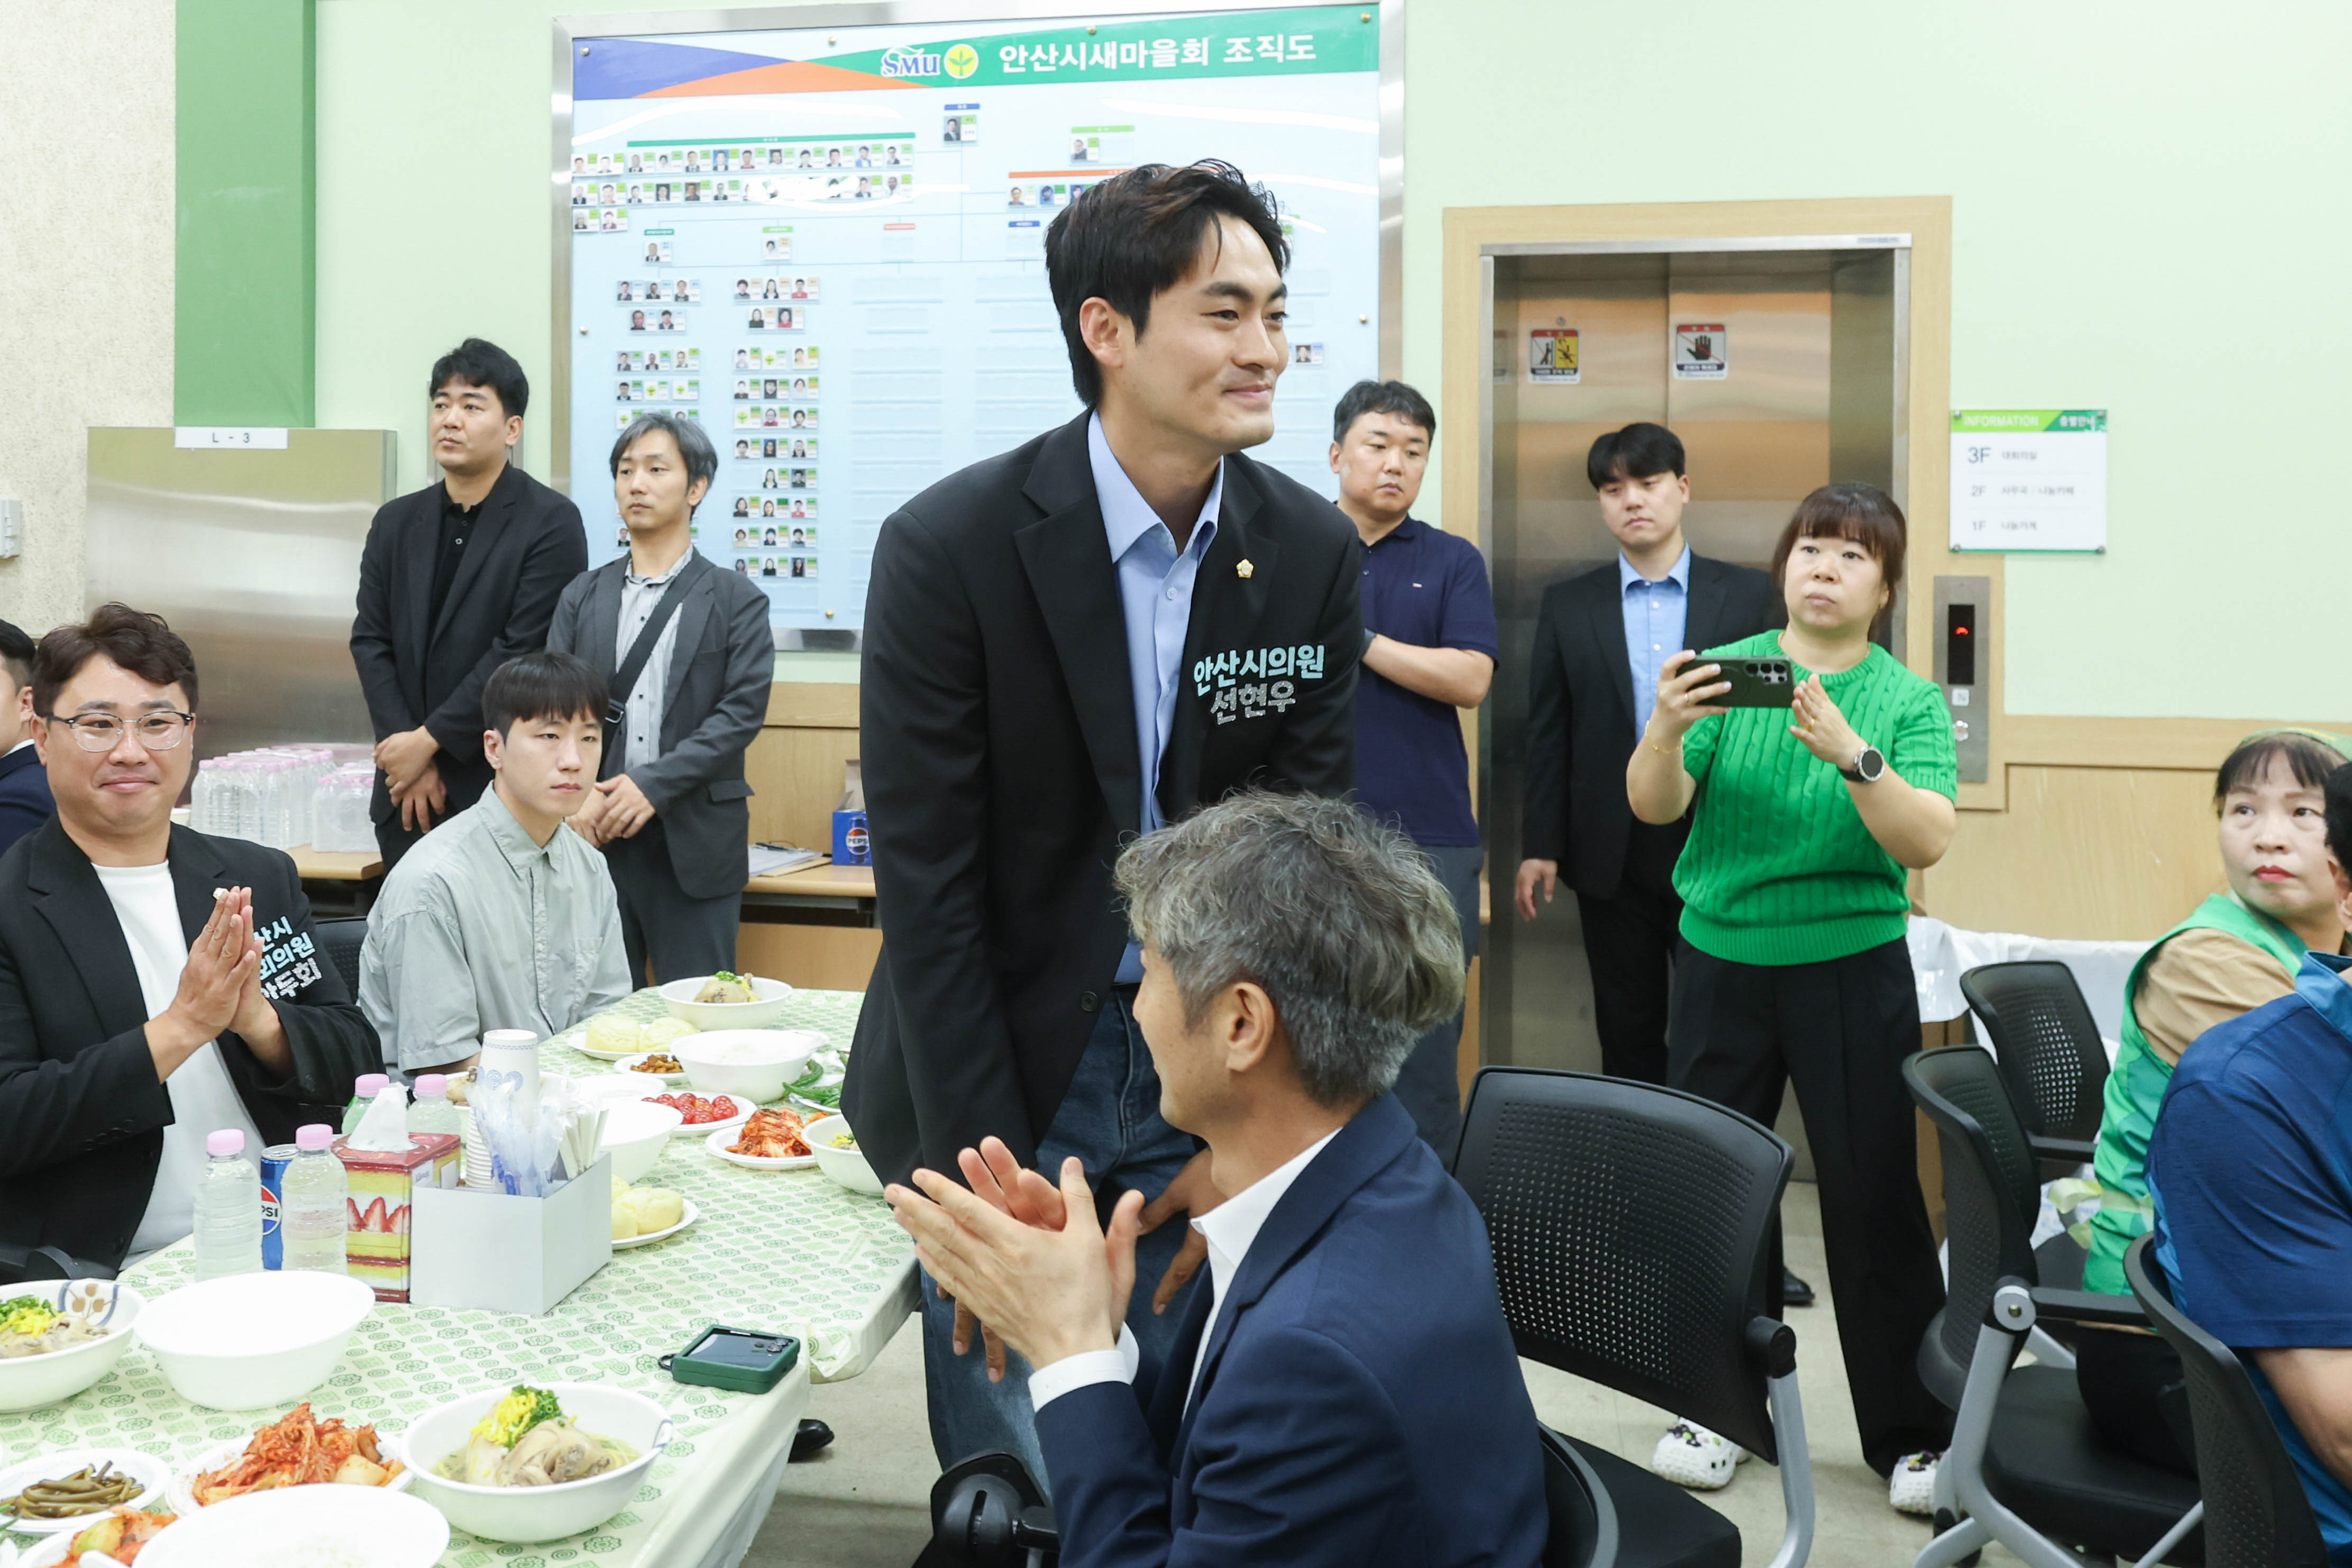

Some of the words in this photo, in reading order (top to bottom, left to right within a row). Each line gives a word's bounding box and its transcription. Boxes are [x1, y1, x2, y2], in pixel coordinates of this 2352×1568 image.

[881, 47, 941, 77] SMU
[999, 38, 1210, 73] 안산시새마을회
[1223, 34, 1316, 63] 조직도
[1964, 415, 2039, 427] INFORMATION
[1967, 446, 1992, 464] 3F
[1971, 485, 1987, 497] 2F
[1972, 519, 1987, 531] 1F
[1193, 644, 1325, 696] 안산시의원
[1210, 680, 1296, 726] 선현우
